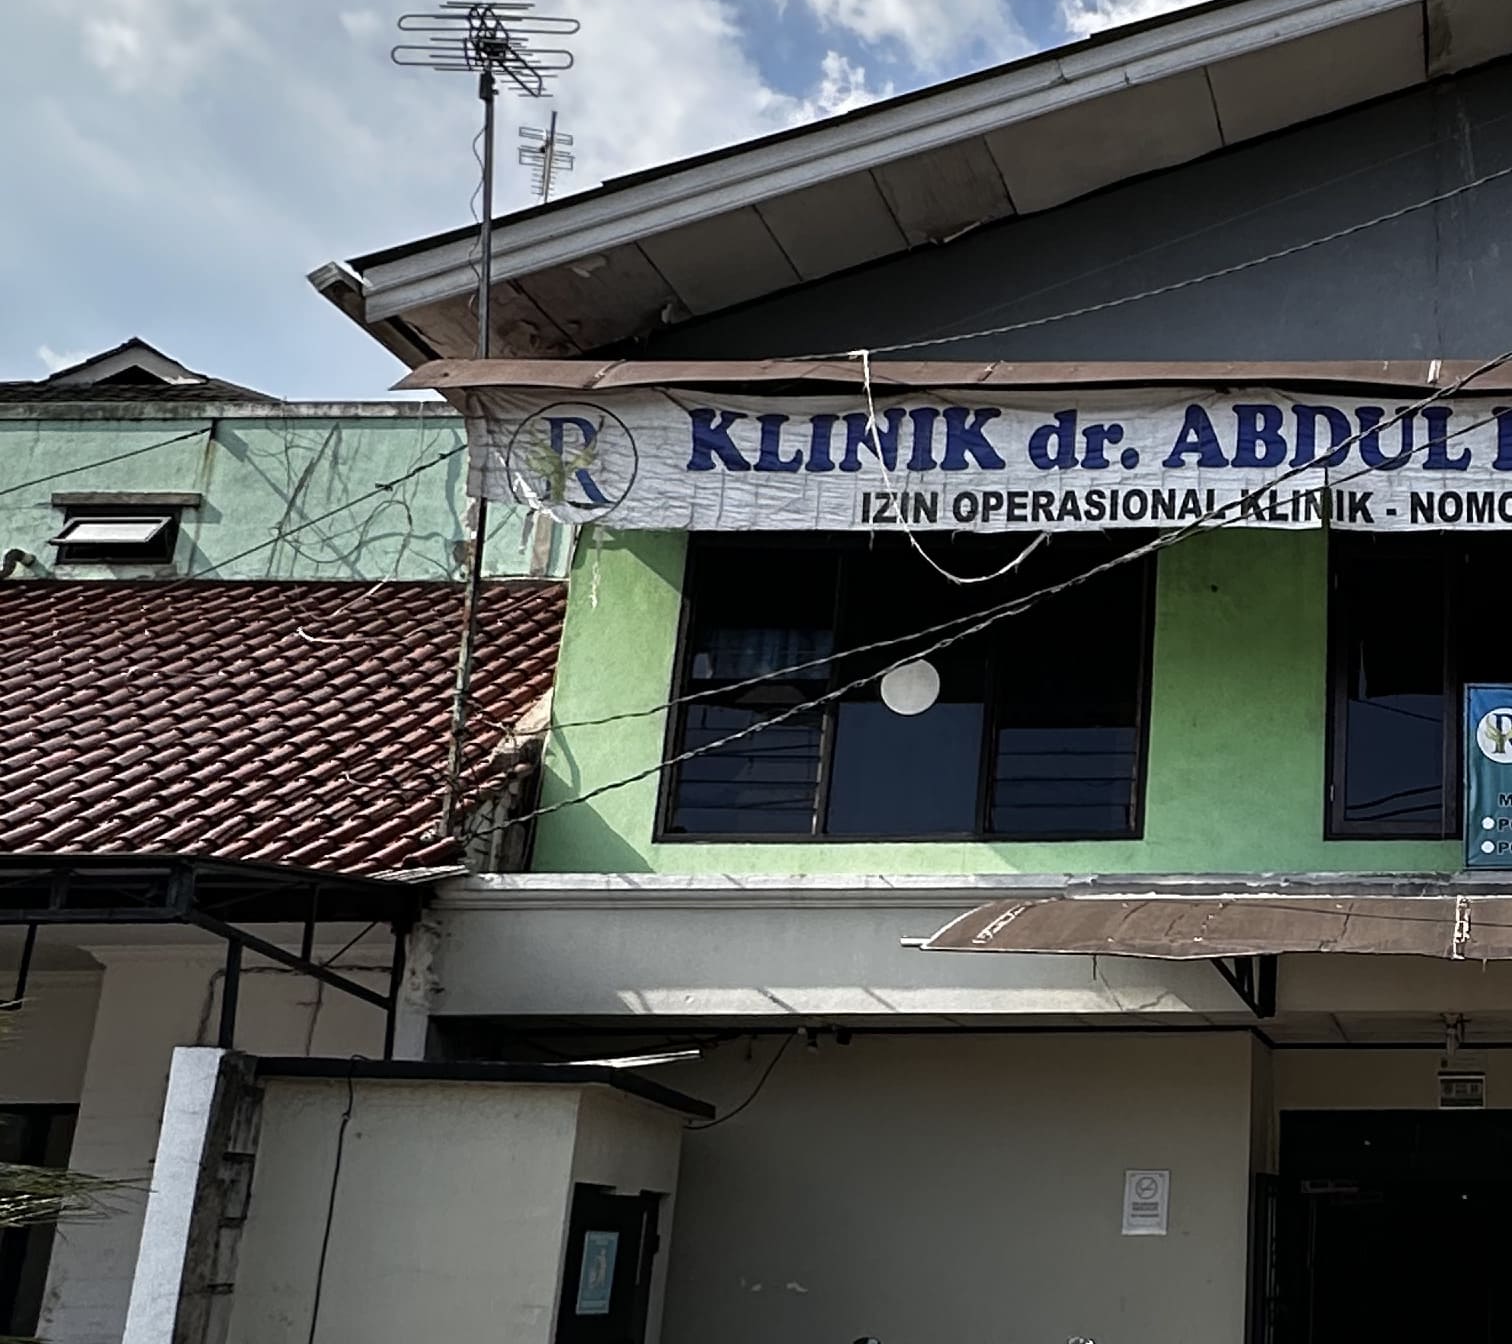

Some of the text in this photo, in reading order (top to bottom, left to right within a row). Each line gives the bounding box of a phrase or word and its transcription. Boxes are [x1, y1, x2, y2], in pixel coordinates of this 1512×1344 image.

[687, 407, 1006, 472] KLINIK
[1028, 409, 1139, 470] dr.
[1162, 404, 1471, 471] ABDUL
[861, 490, 938, 524] IZIN
[952, 488, 1226, 523] OPERASIONAL
[1241, 488, 1373, 524] KLINIK
